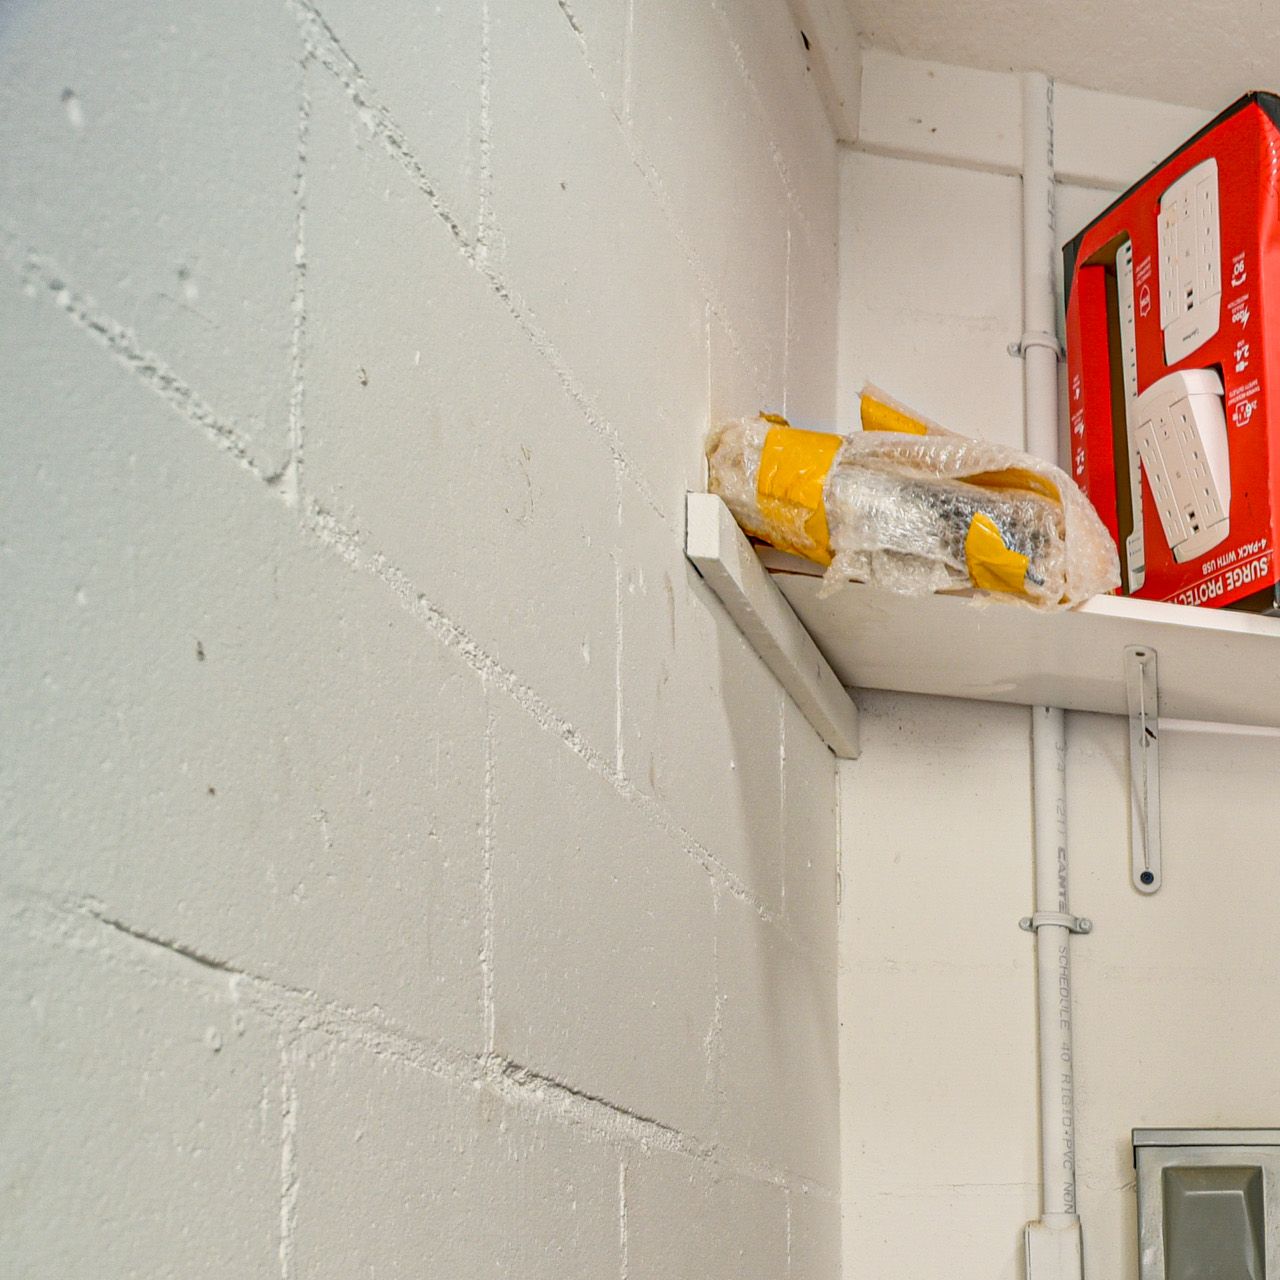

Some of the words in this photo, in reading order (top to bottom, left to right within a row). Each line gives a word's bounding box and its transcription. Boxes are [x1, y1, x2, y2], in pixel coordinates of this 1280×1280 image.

[1217, 550, 1237, 569] WITH
[1237, 538, 1267, 560] 4-PACK
[1201, 560, 1217, 575] USB
[1225, 556, 1268, 591] SURGE
[1168, 576, 1224, 606] PROTEC
[1057, 846, 1068, 913] CANTE
[1058, 945, 1071, 1031] SCHEDULE
[1060, 1042, 1071, 1063] 40
